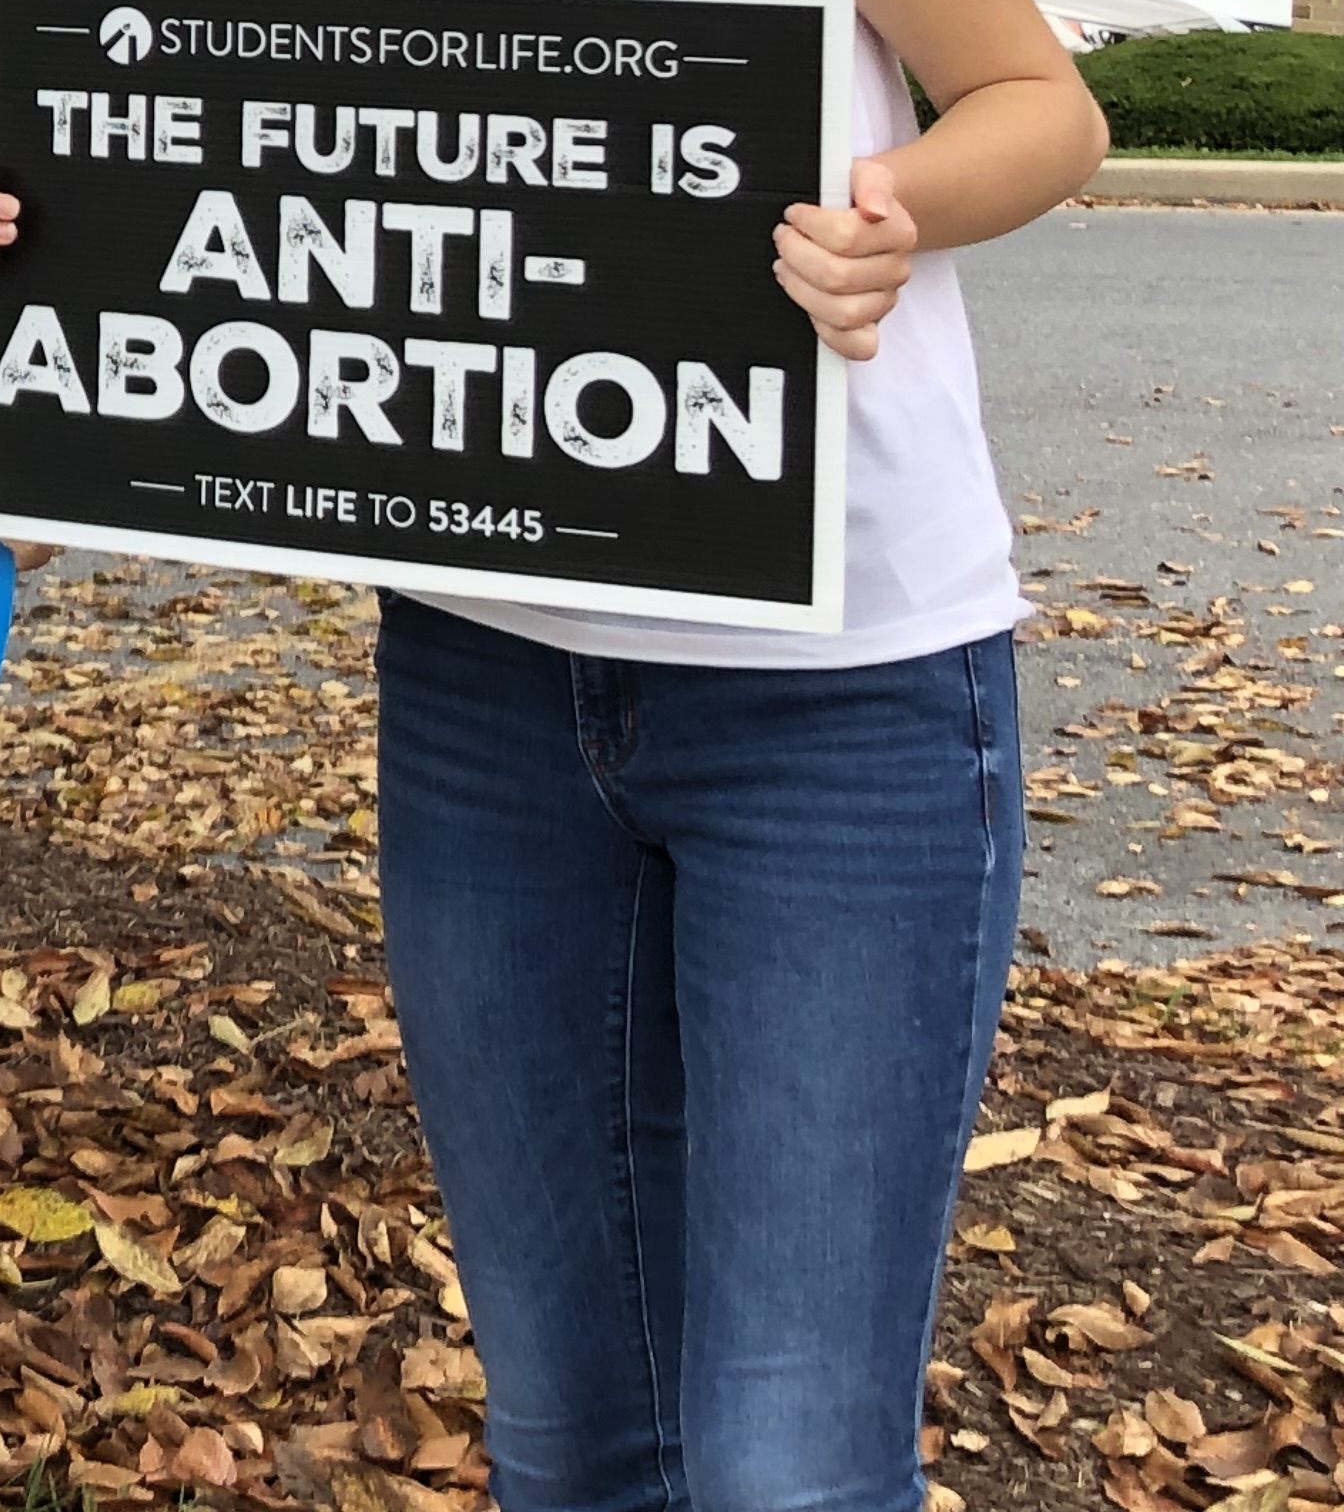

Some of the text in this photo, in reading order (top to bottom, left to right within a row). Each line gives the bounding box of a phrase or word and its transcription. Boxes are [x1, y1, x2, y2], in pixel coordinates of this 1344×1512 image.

[159, 19, 680, 79] STUDENTSFORLIFE.ORG
[37, 89, 742, 199] THE FUTURE IS
[159, 190, 587, 320] ANTI-
[194, 473, 544, 542] TEXT LIFE TO 53445
